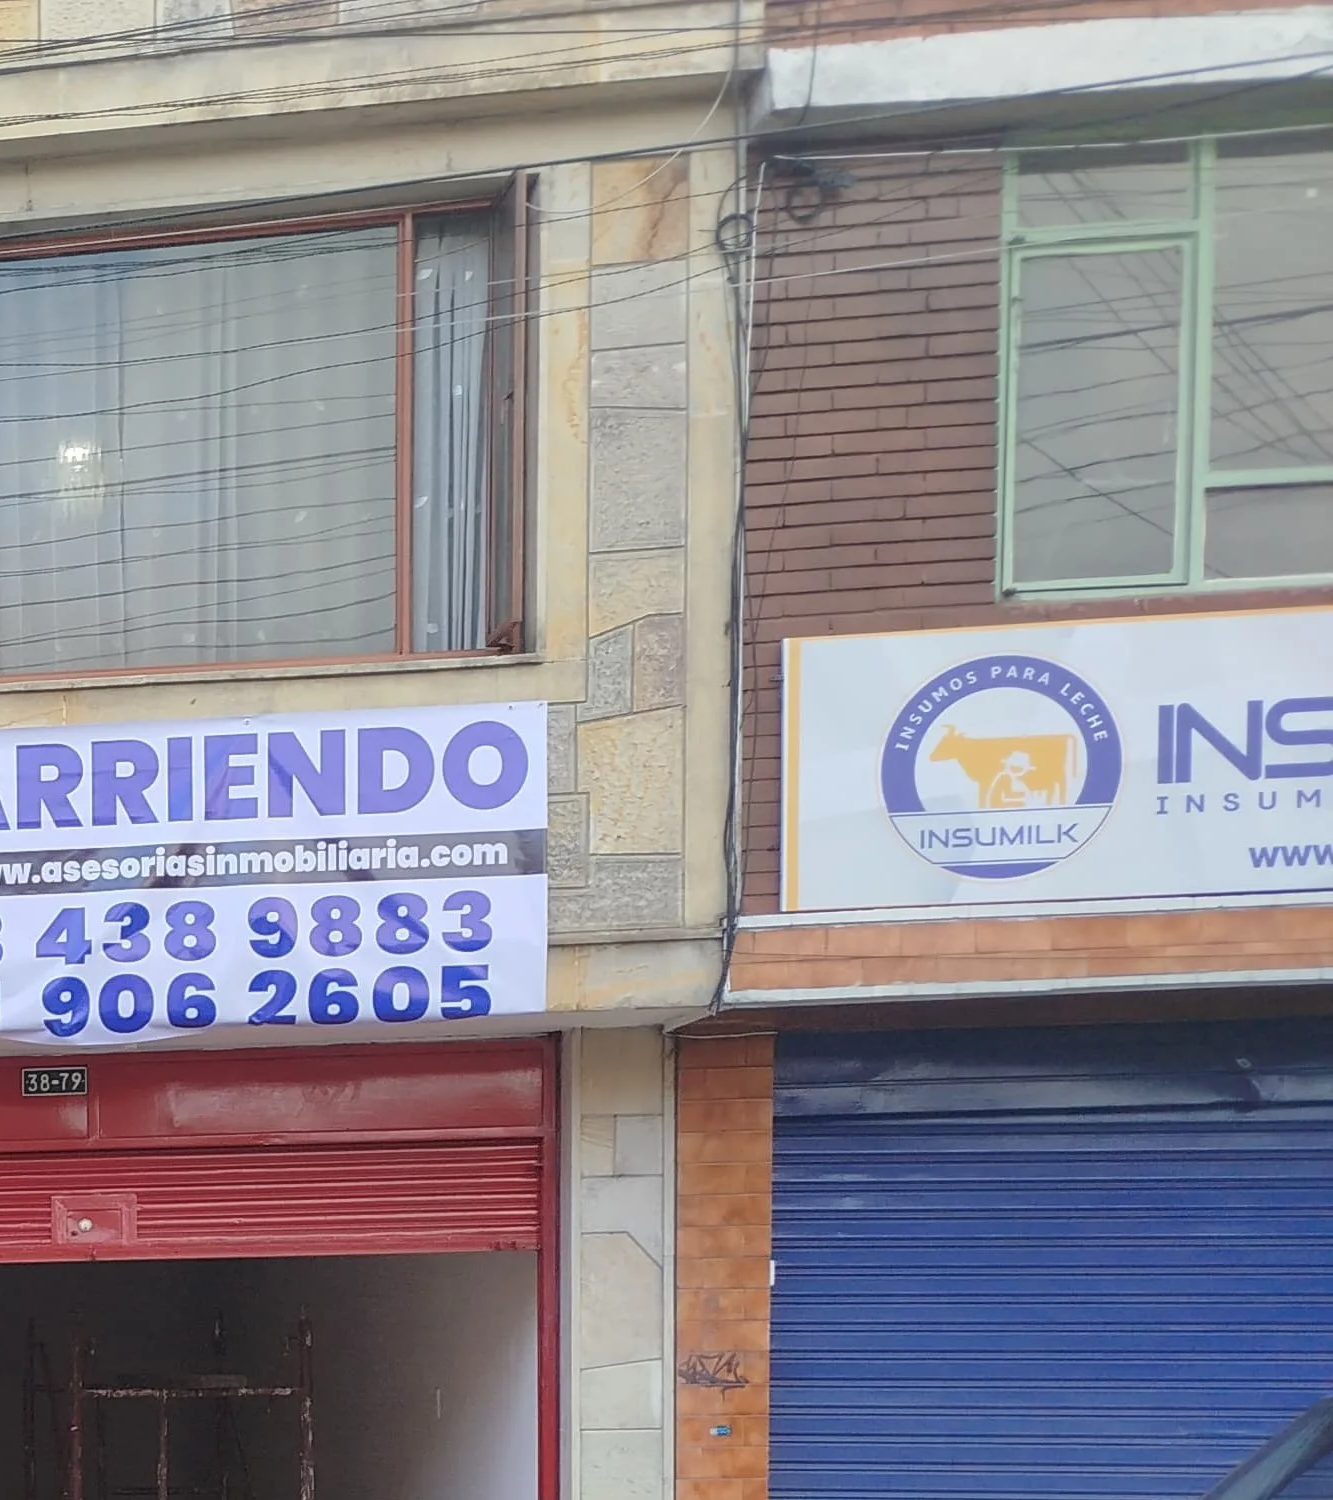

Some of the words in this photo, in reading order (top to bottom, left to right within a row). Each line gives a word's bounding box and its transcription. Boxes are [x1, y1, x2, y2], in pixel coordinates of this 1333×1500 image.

[895, 671, 978, 751] INSUMOS
[991, 665, 1051, 685] PARA
[1060, 682, 1108, 742] LECHE
[1156, 788, 1321, 815] INSUM
[920, 823, 1079, 849] INSUMILK
[35, 900, 217, 965] 438
[247, 890, 492, 958] 9883
[41, 972, 217, 1037] 906
[247, 964, 491, 1024] 2605
[27, 1072, 82, 1092] 38-79
